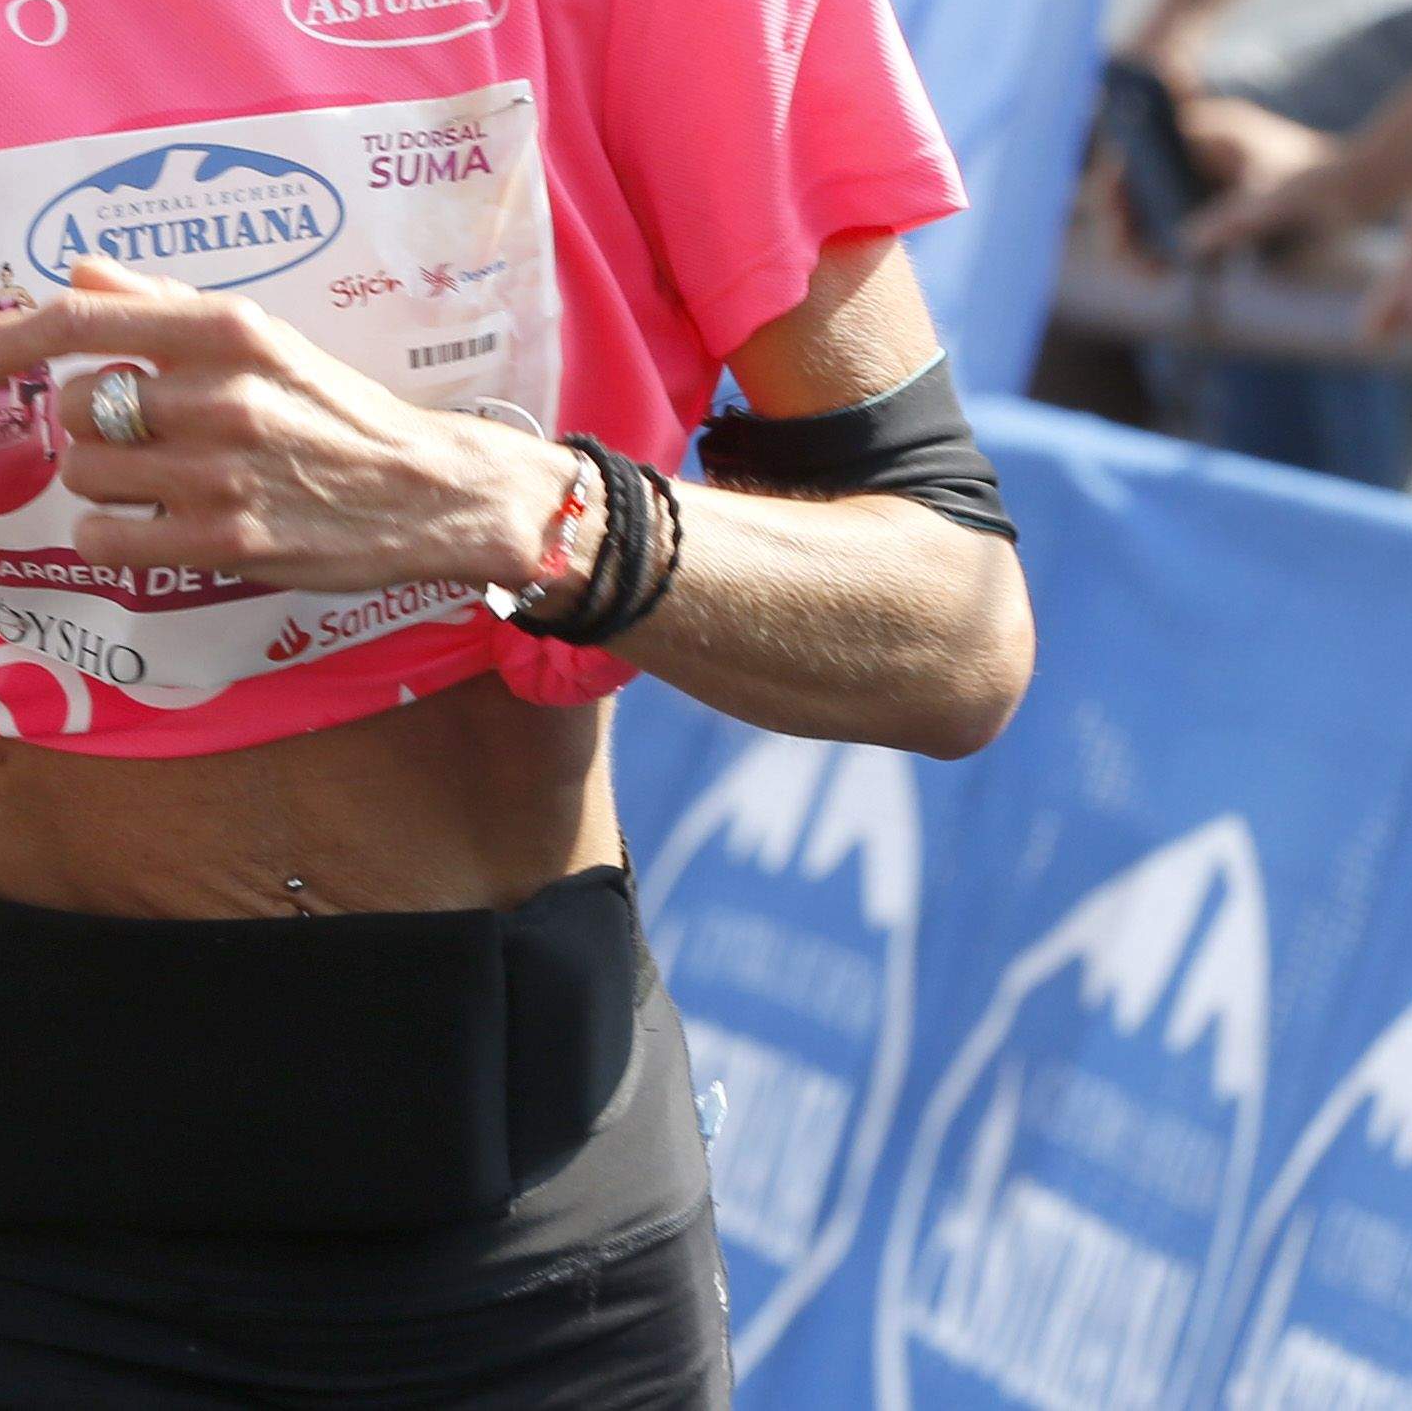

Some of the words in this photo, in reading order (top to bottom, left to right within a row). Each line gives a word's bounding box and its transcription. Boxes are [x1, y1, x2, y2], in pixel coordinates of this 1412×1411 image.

[362, 133, 391, 153] TU
[399, 120, 488, 150] DORSAL
[369, 145, 493, 189] SUMA
[96, 193, 196, 220] CENTRAL
[205, 181, 309, 207] LECHERA
[52, 203, 323, 269] ASTURIANA
[145, 564, 203, 596] DE
